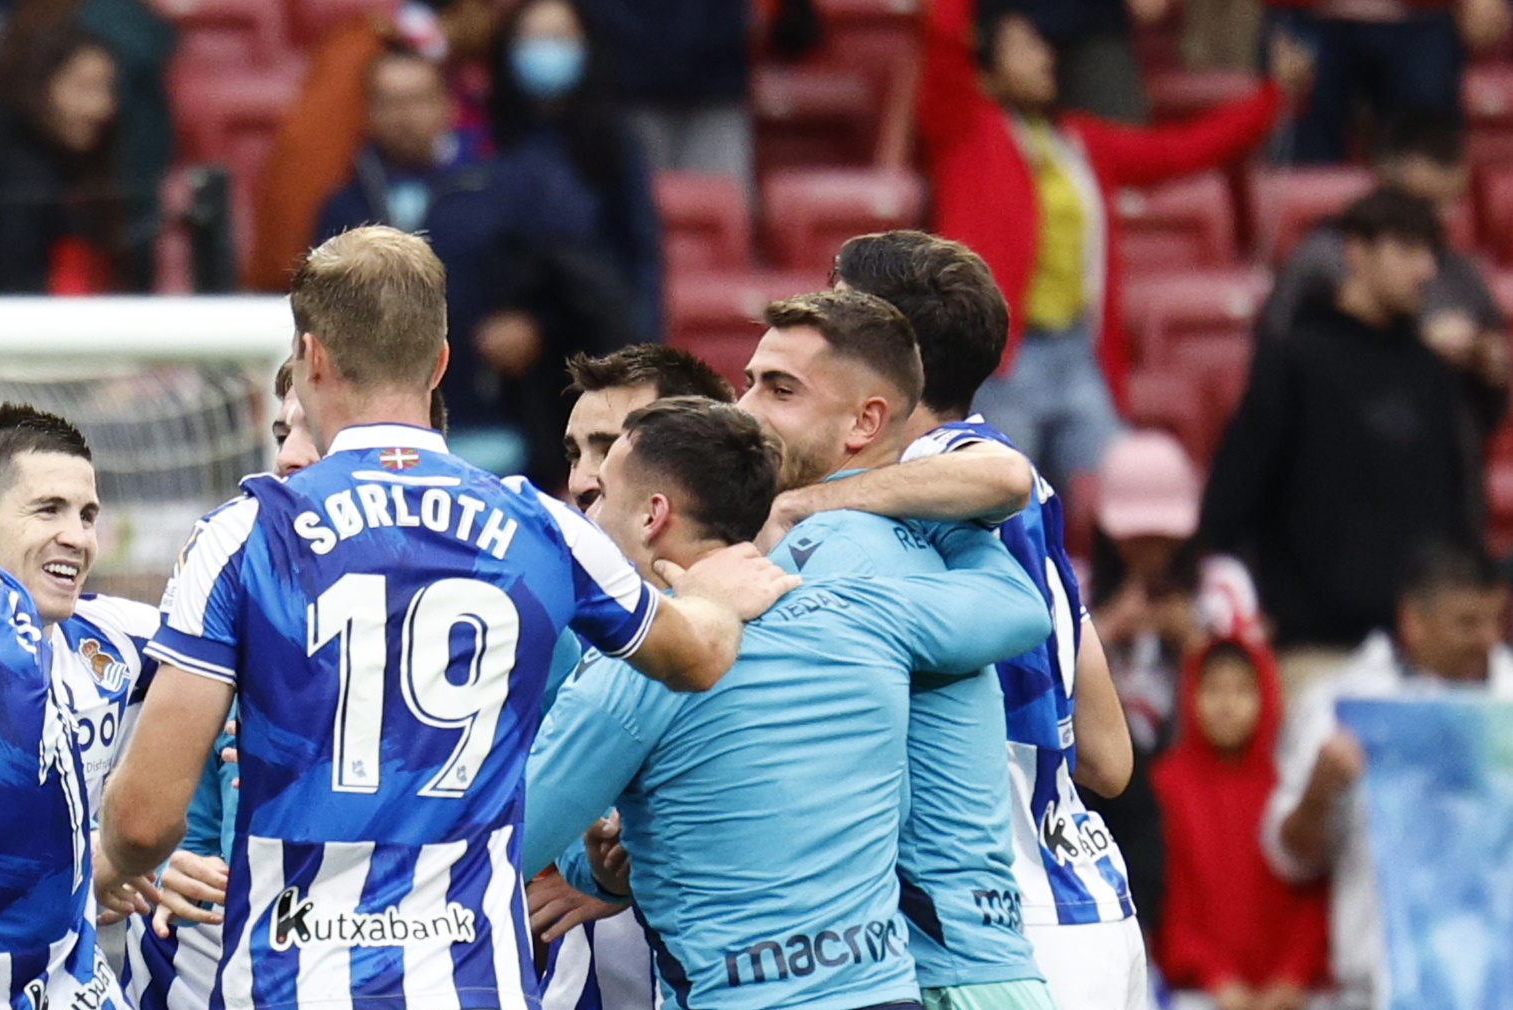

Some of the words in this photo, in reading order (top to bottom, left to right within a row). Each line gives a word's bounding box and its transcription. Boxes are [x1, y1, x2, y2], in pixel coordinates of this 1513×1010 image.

[294, 484, 519, 560] SØRLOTH
[307, 572, 520, 798] 19
[276, 889, 471, 944] Kutxabank
